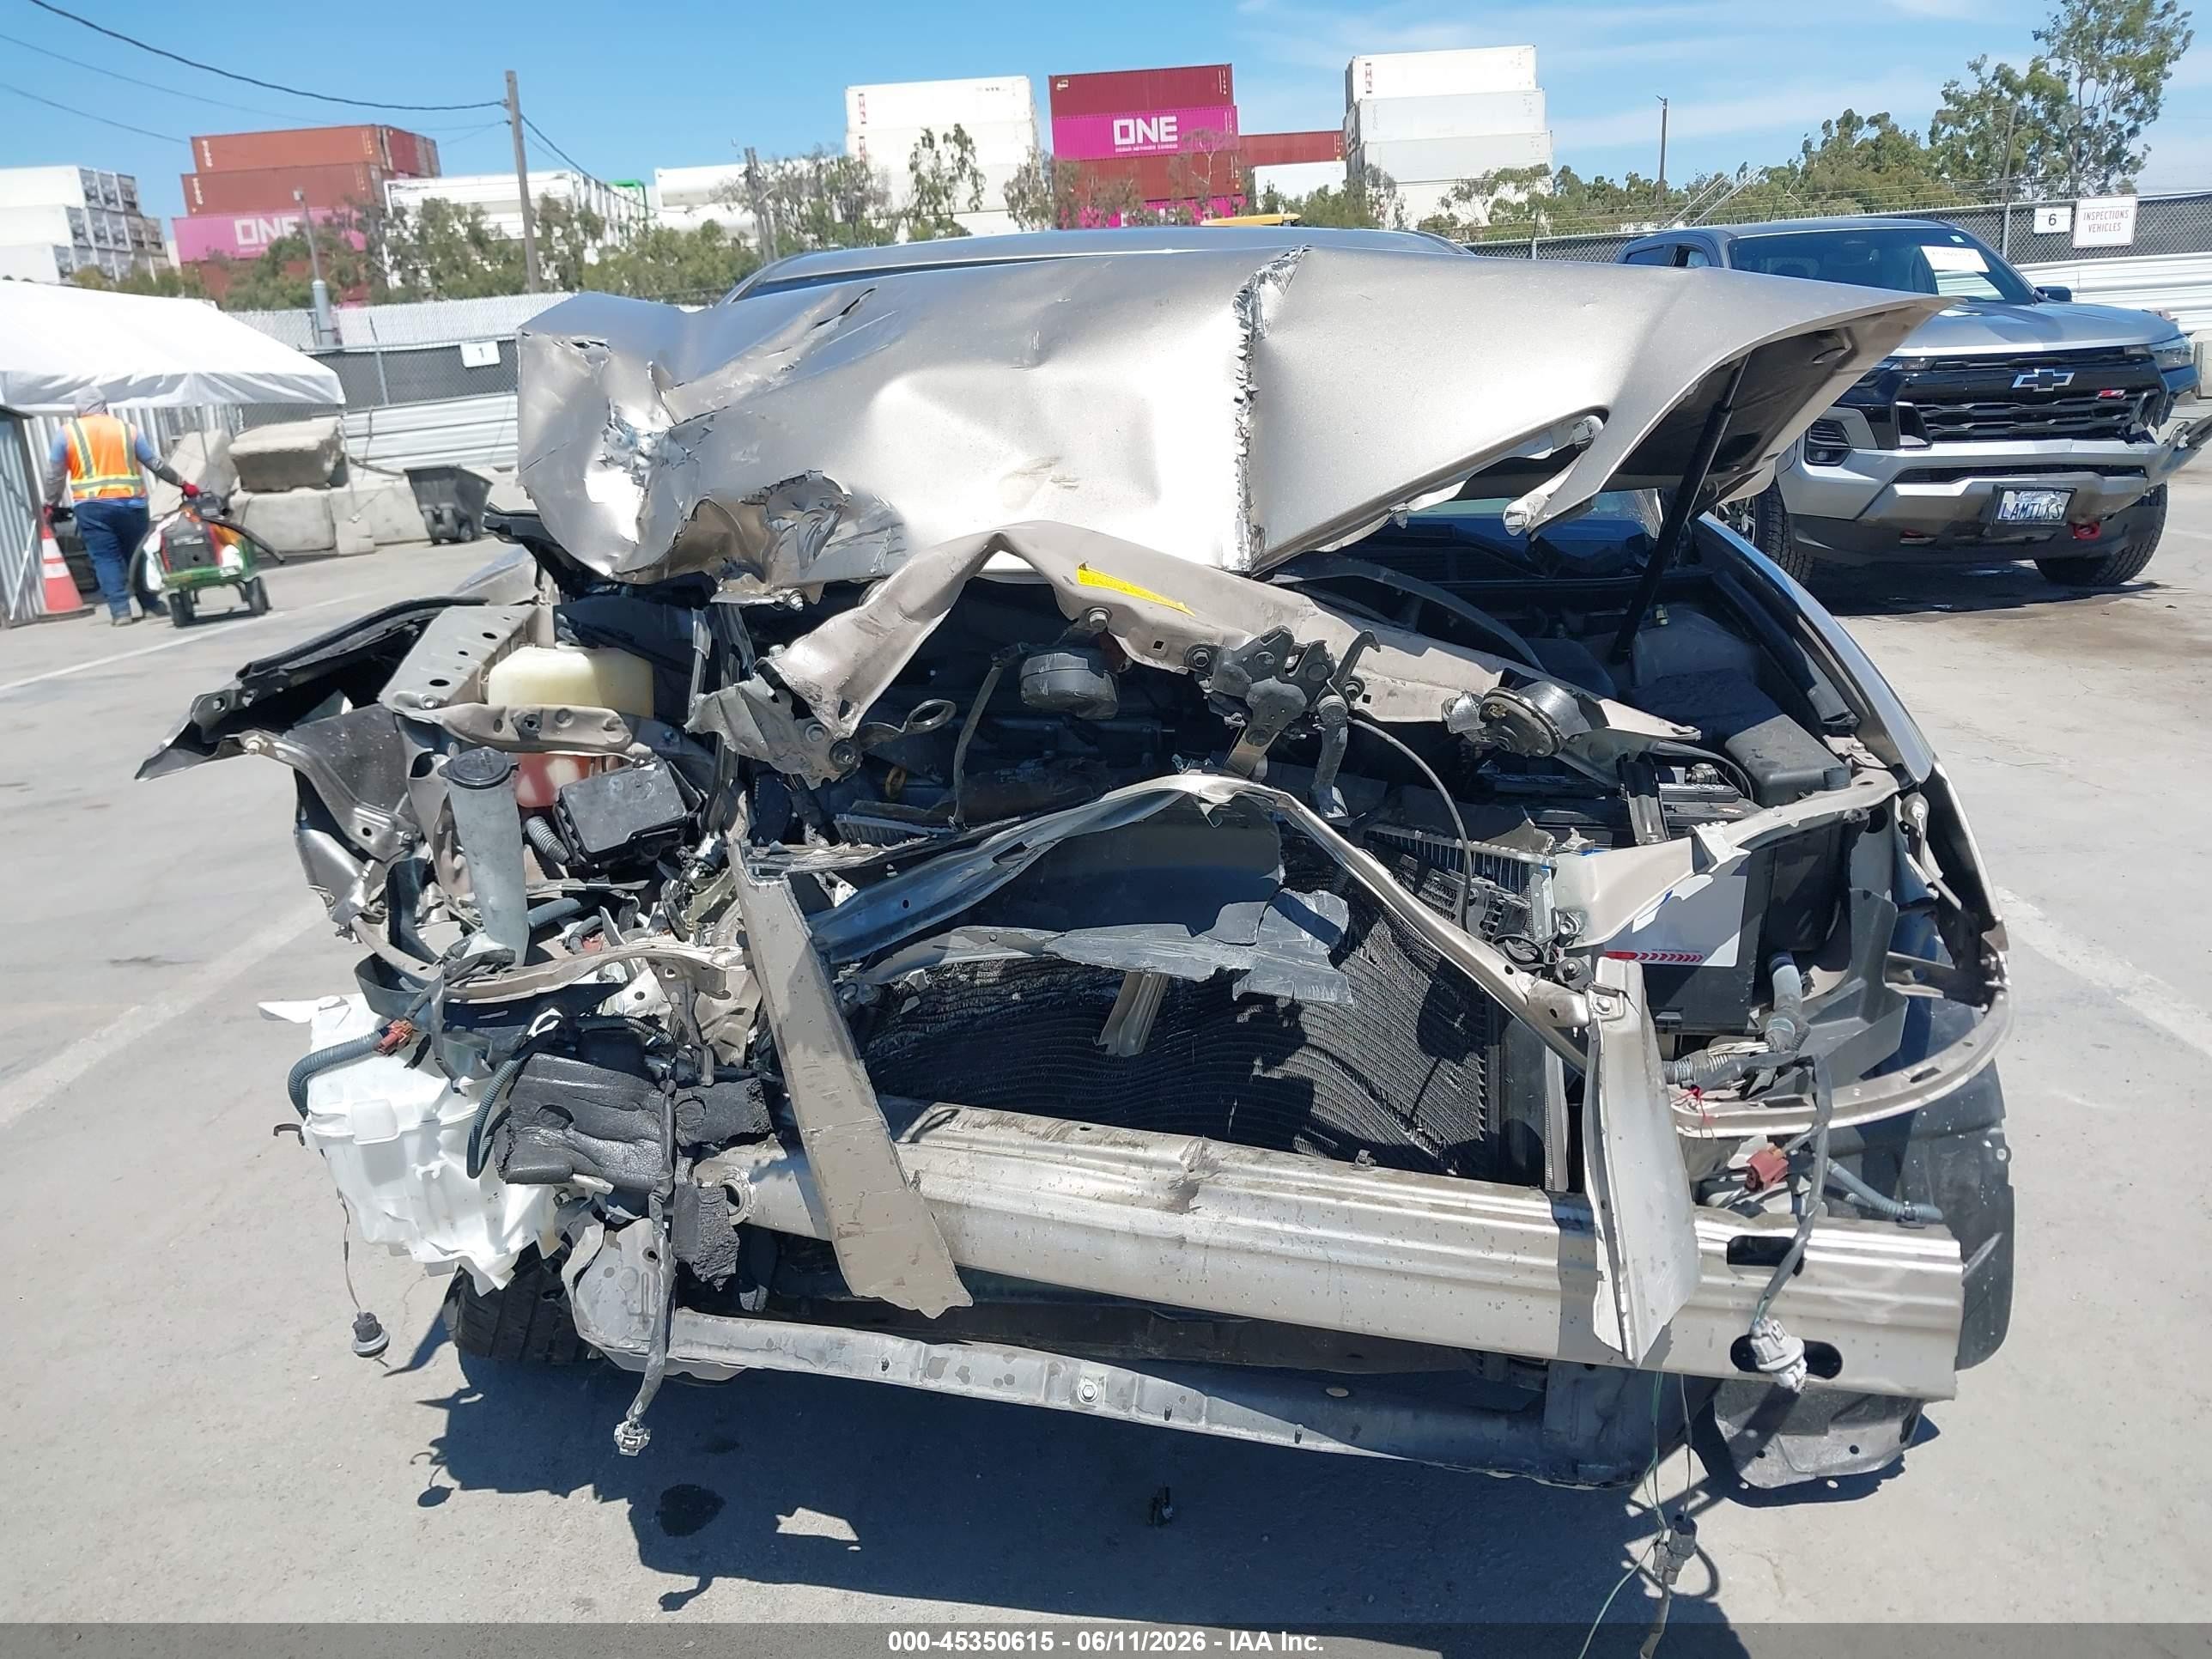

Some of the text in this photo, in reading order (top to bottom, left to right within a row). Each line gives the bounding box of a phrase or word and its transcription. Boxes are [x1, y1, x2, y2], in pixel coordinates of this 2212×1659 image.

[1113, 116, 1177, 145] ONE
[2048, 213, 2057, 226] 6
[2083, 210, 2130, 220] INSPECTIONS
[2088, 222, 2122, 233] VEHICLES
